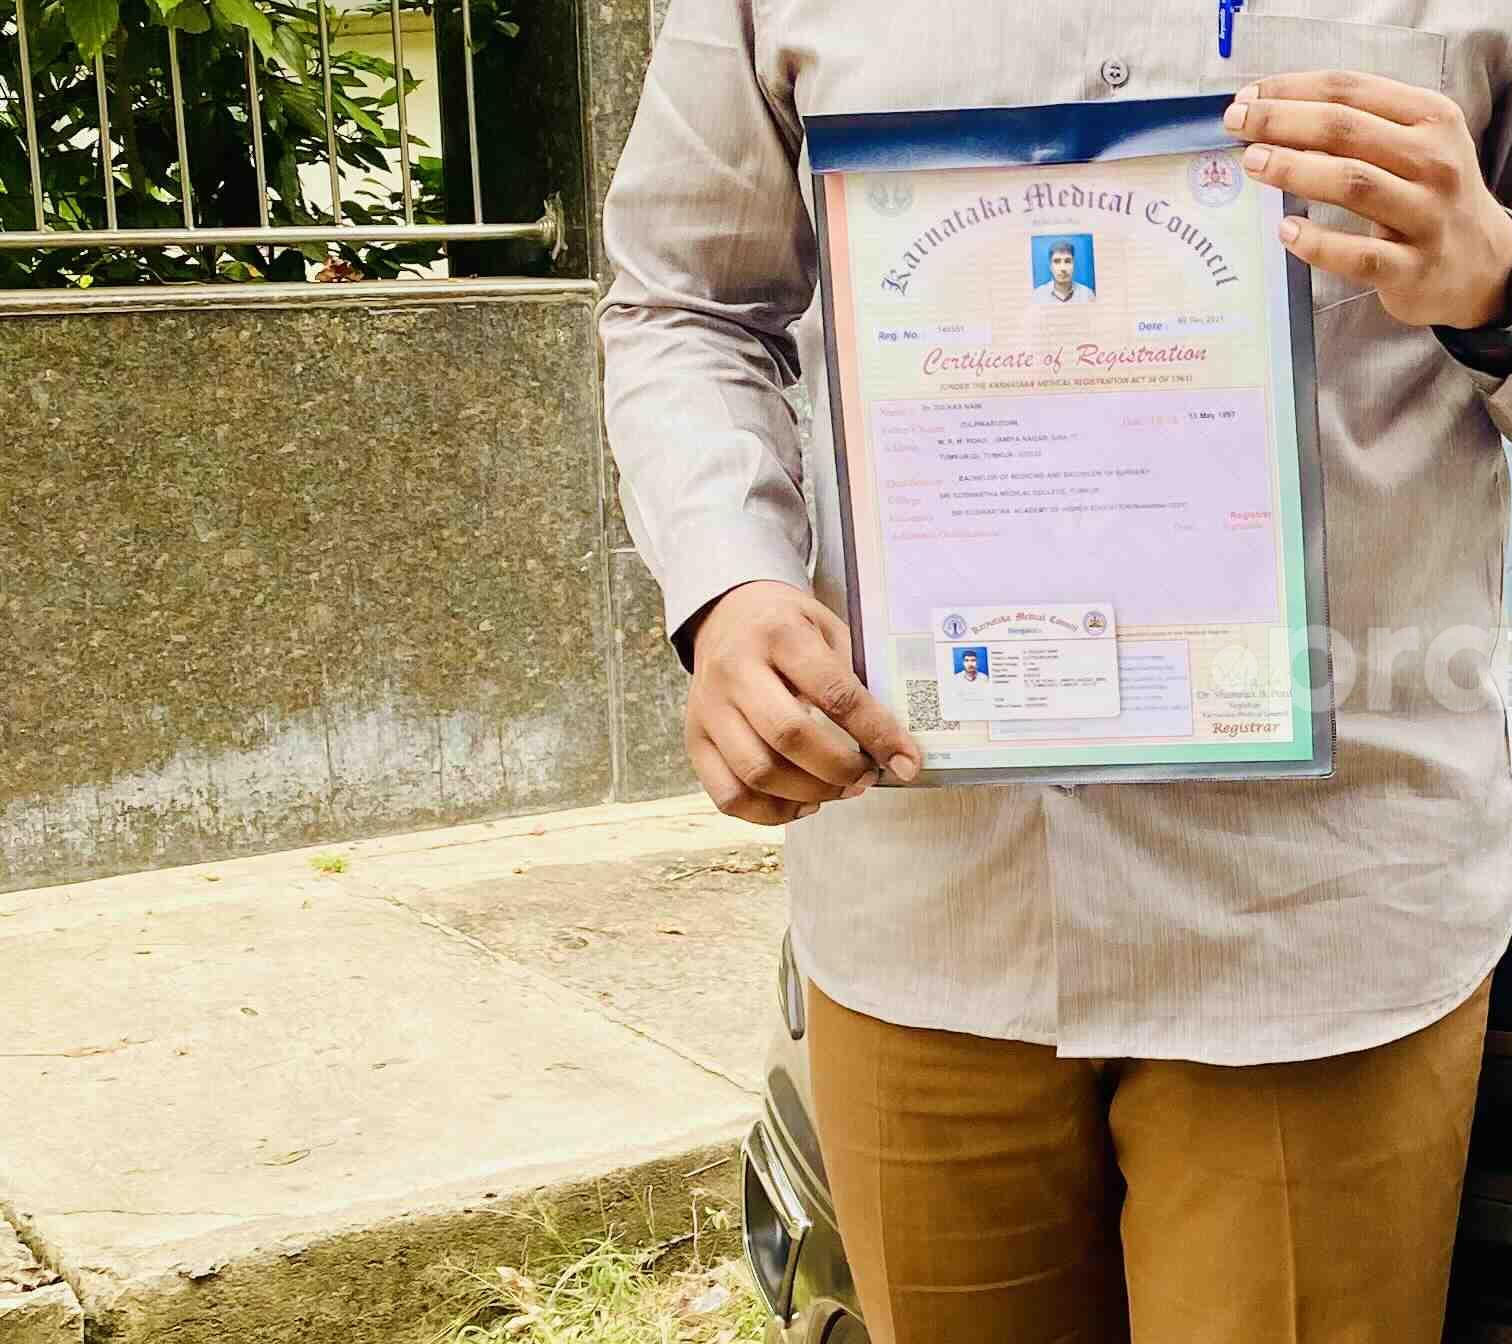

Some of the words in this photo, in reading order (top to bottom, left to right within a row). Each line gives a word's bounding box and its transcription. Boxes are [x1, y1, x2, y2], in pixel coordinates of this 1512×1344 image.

[880, 194, 1012, 297] Karnataka
[1021, 181, 1136, 217] Medical
[1144, 198, 1240, 288] Council
[922, 346, 1034, 377] Certificate
[1042, 345, 1064, 374] of
[1075, 343, 1208, 371] Registration
[1212, 721, 1281, 738] Registrar
